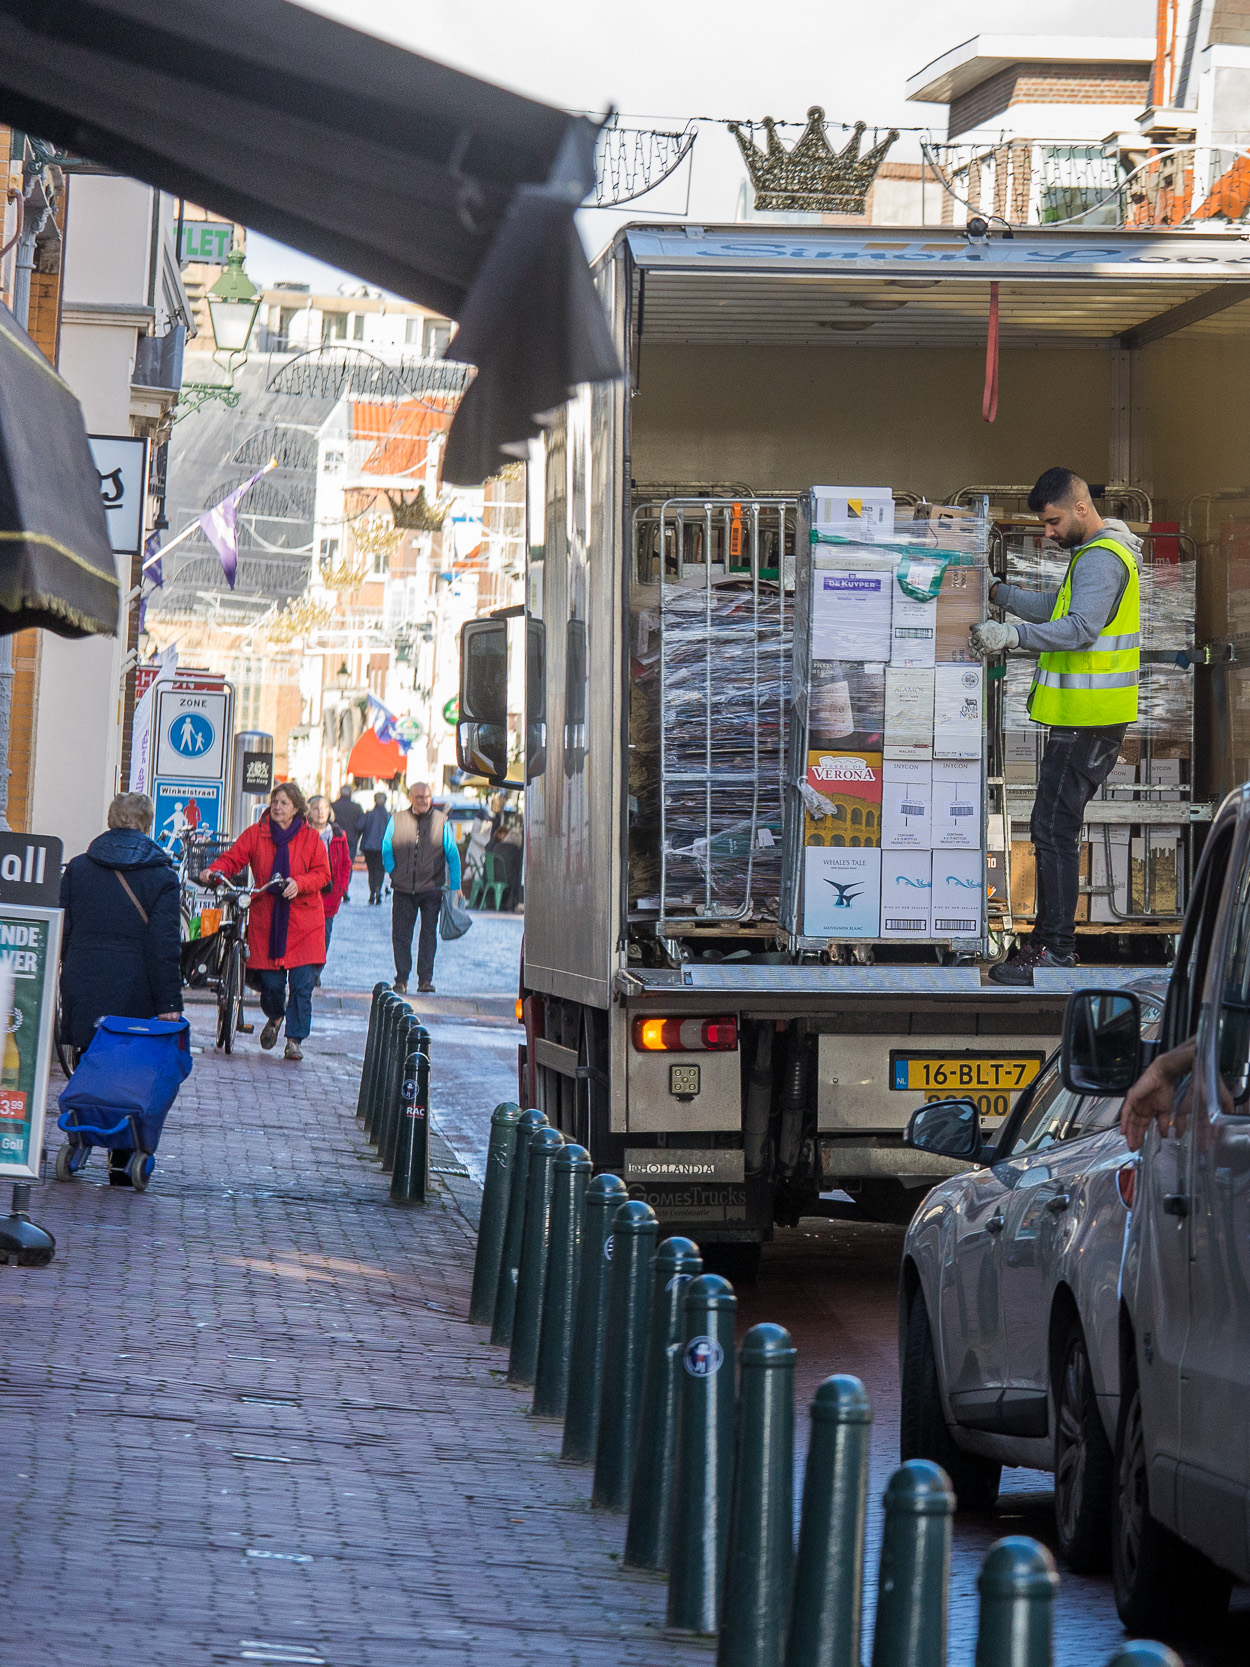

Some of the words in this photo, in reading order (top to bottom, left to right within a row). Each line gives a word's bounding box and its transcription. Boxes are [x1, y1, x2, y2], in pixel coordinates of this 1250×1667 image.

[696, 243, 984, 261] Simon
[180, 698, 207, 708] ZONE
[813, 767, 874, 780] VERONA
[162, 787, 215, 796] Winkelstraat
[0, 926, 40, 947] NDE
[896, 1077, 907, 1085] NL
[923, 1063, 1027, 1086] 16-BLT-7
